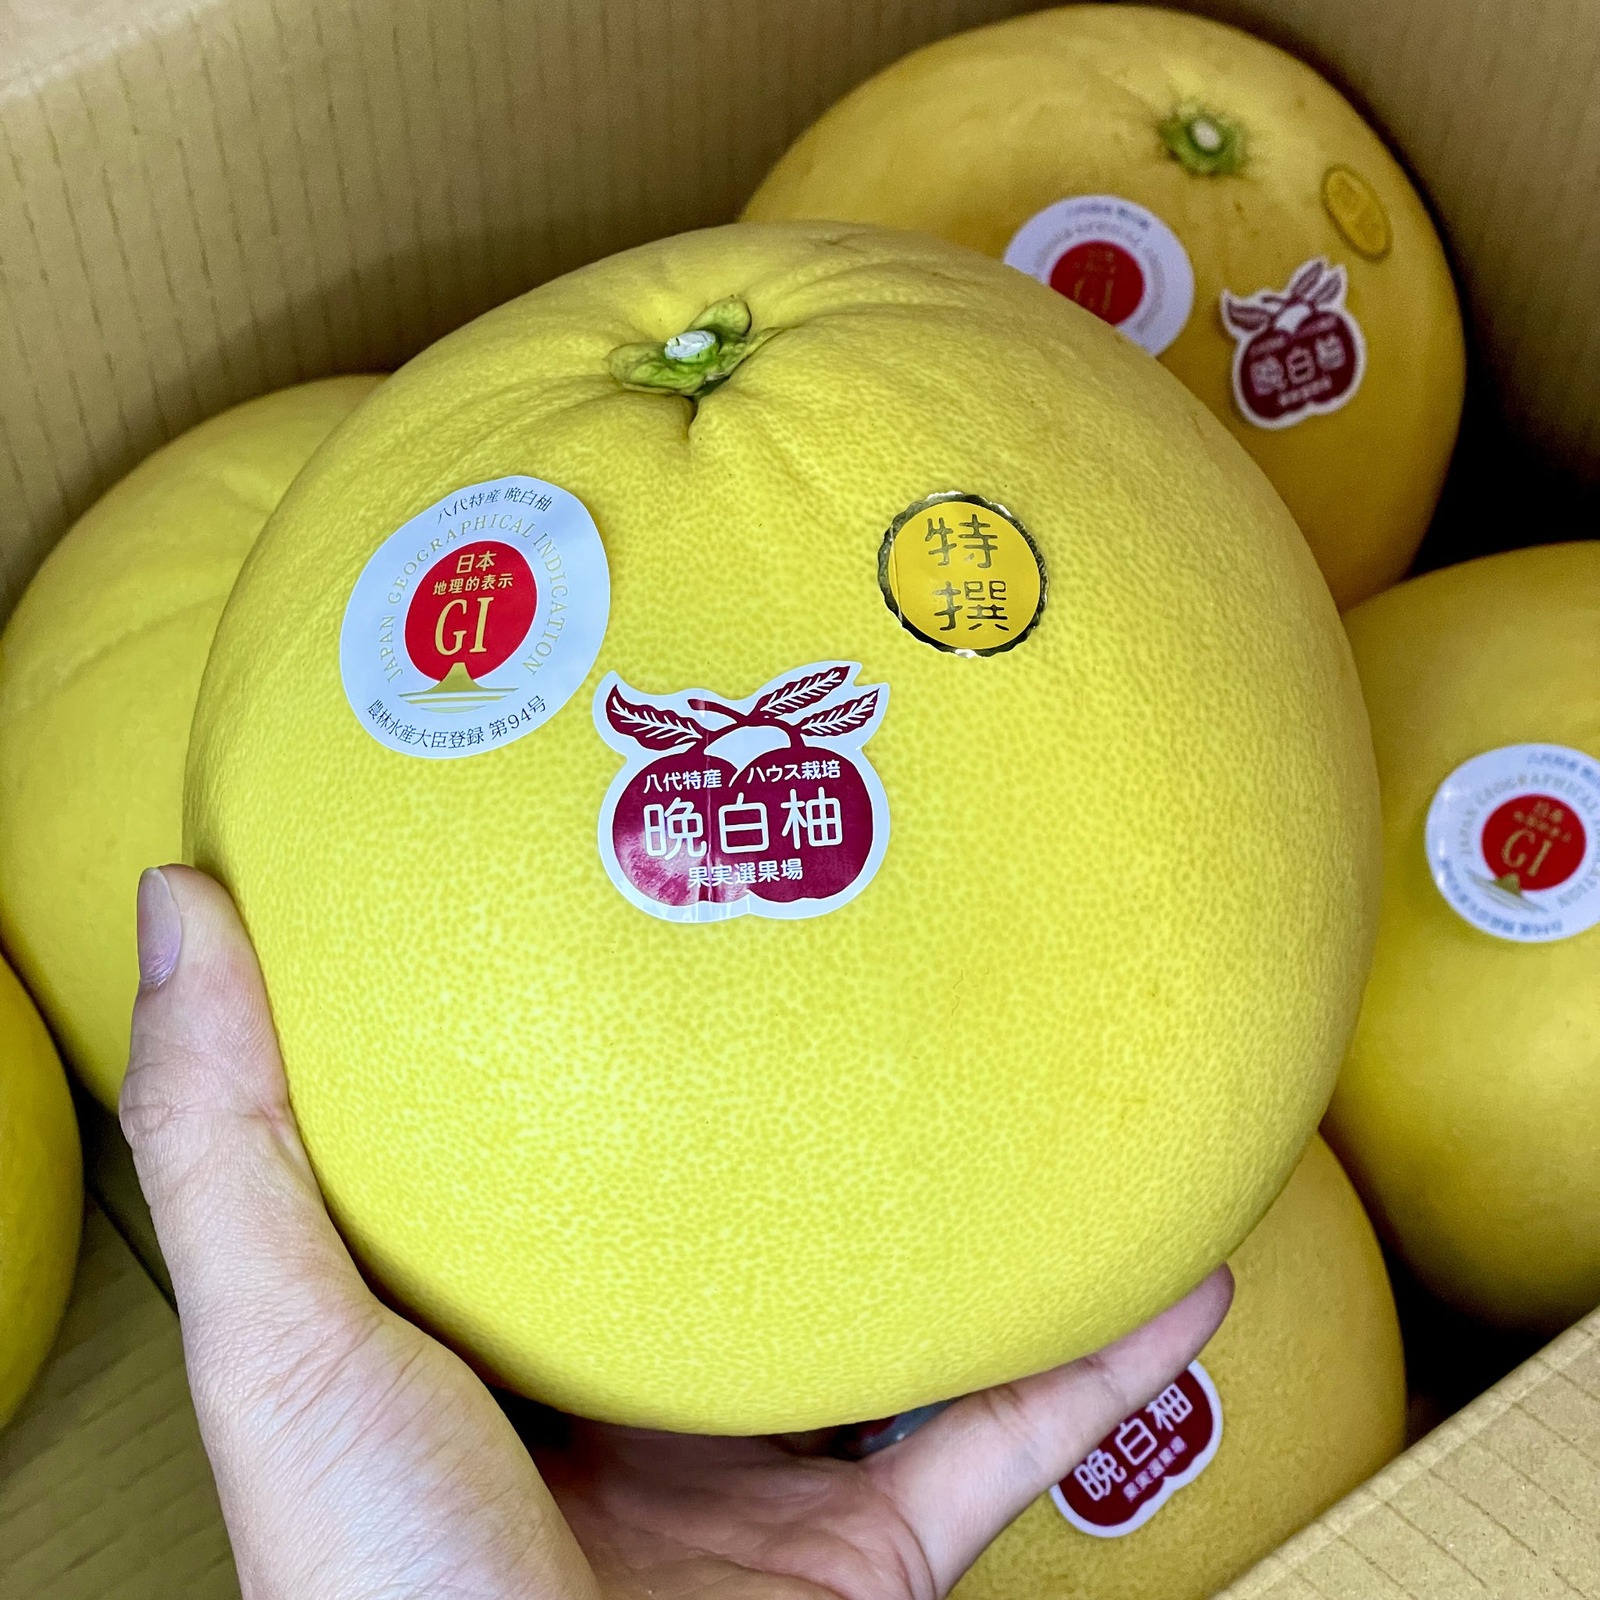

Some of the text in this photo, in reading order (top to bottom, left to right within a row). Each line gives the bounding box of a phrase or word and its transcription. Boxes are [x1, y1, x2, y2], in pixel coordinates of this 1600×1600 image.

[437, 487, 553, 525] 八代特産 晩白柚
[432, 573, 514, 596] 地理的表示
[455, 550, 497, 574] 日本
[925, 513, 1010, 631] 特撰
[379, 513, 569, 683] JAPAN GEOGRAPHICAL INDICATION
[434, 596, 495, 656] GI
[366, 695, 547, 749] 農林水産大臣登録 第94号
[643, 759, 841, 794] 八代特産 ハウス栽培
[643, 786, 843, 860] 晩白柚
[688, 858, 803, 888] 果実選果場
[1074, 1383, 1193, 1501] 晩白柚
